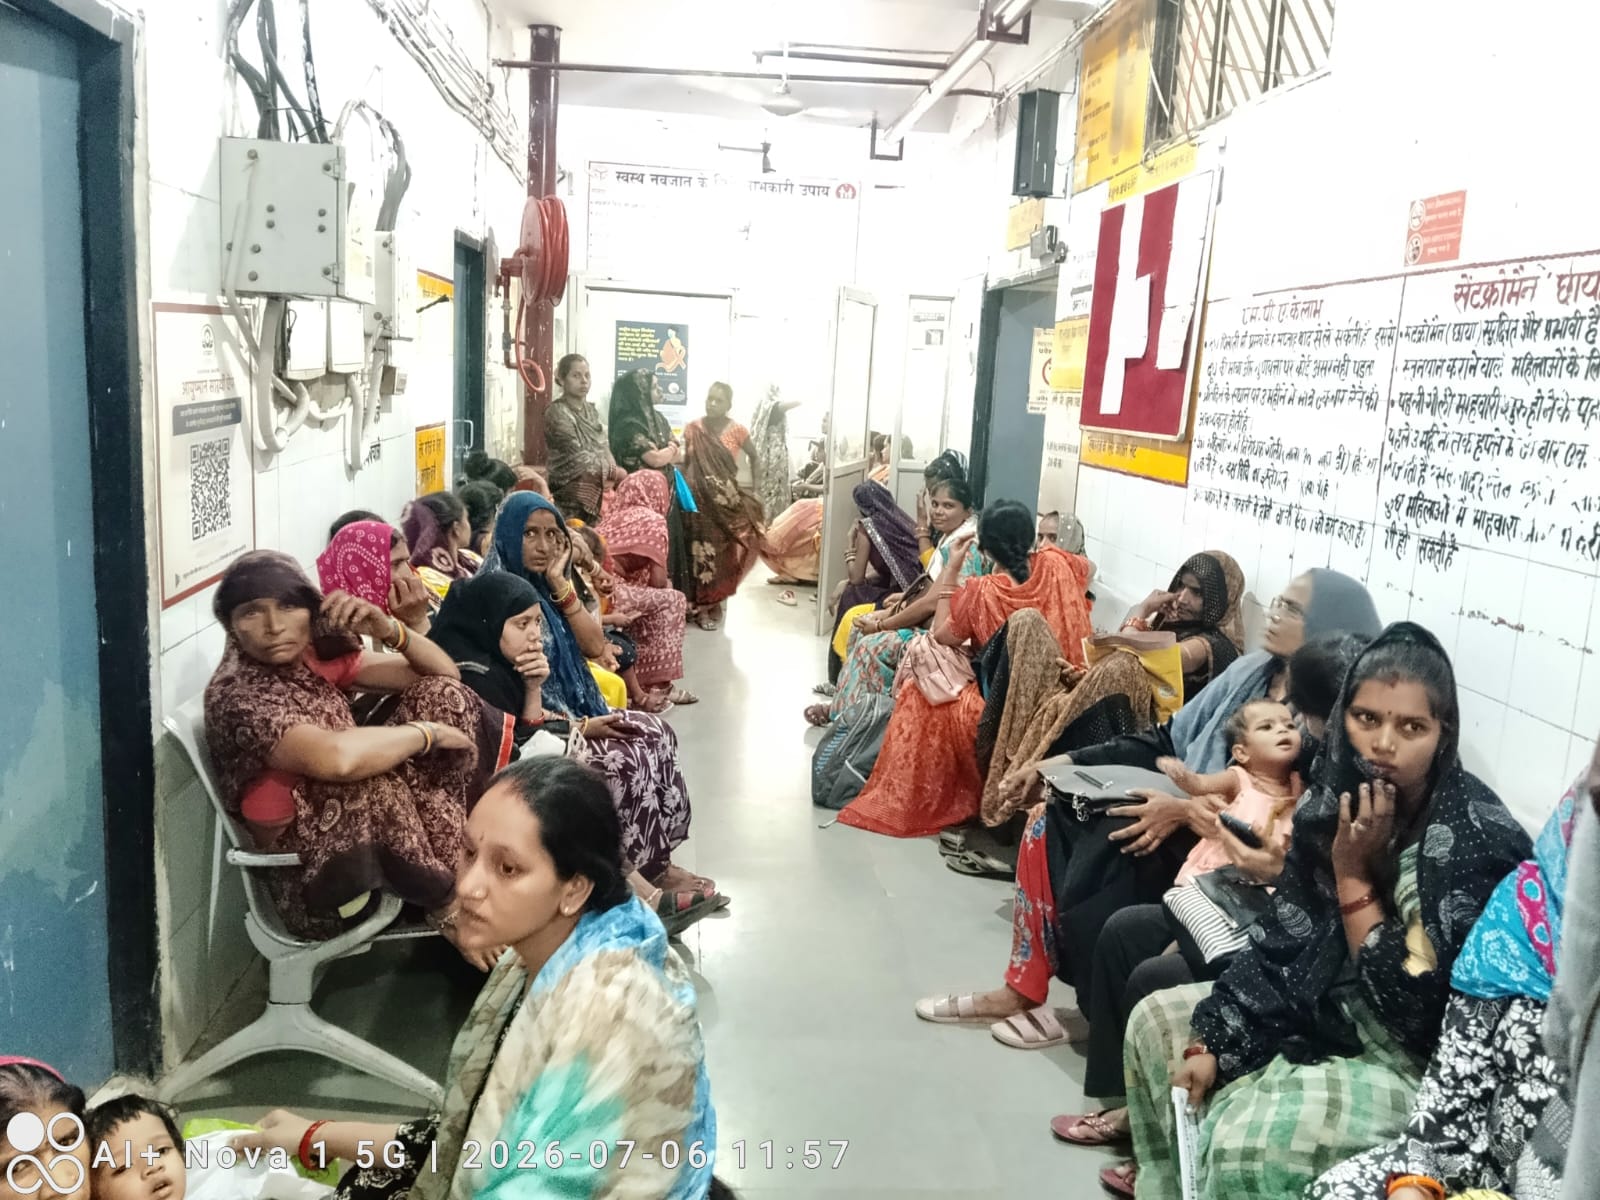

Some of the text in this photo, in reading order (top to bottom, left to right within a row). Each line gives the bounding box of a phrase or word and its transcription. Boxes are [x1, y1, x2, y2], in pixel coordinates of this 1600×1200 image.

[615, 171, 646, 185] स्वस्थ
[649, 173, 693, 189] नवजात
[743, 178, 795, 196] ाभकारी
[799, 184, 832, 199] उपाय
[1520, 310, 1543, 343] और
[1543, 308, 1587, 342] प्रभावी
[1510, 346, 1567, 386] महिलाओं
